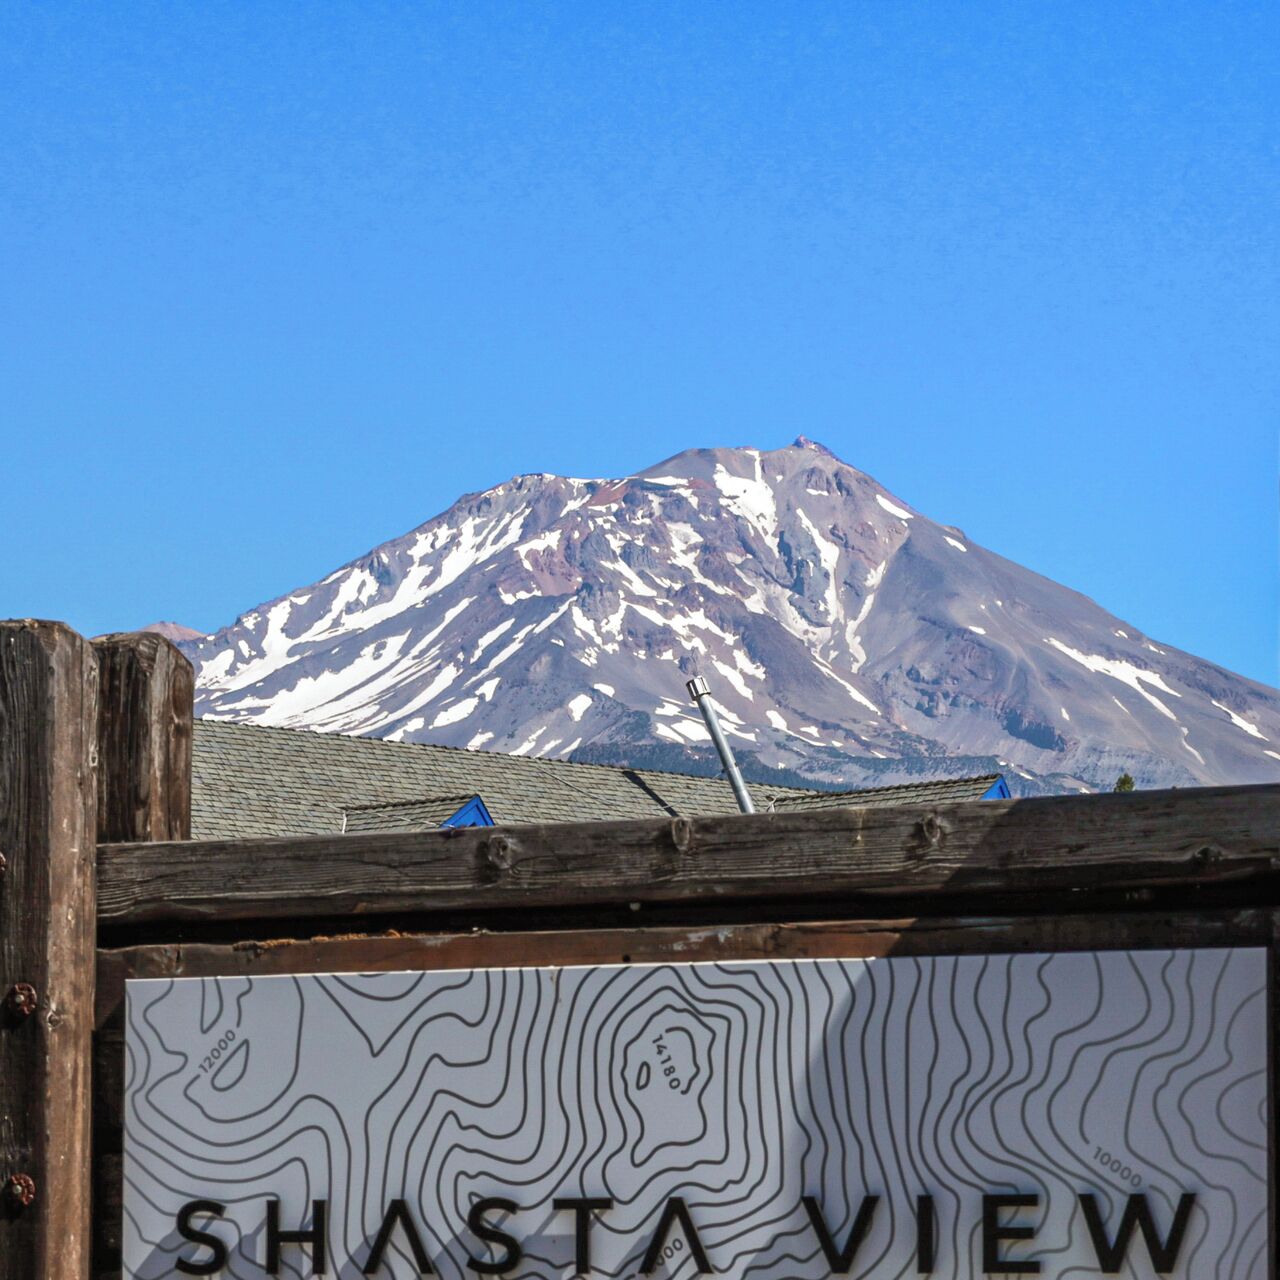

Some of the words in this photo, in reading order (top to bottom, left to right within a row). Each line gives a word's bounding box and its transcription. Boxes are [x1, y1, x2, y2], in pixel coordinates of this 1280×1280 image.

[196, 1028, 238, 1075] 12000
[651, 1032, 682, 1092] 14180
[1091, 1144, 1144, 1189] 10000
[173, 1196, 713, 1277] SHASTA
[801, 1191, 1197, 1276] VIEW
